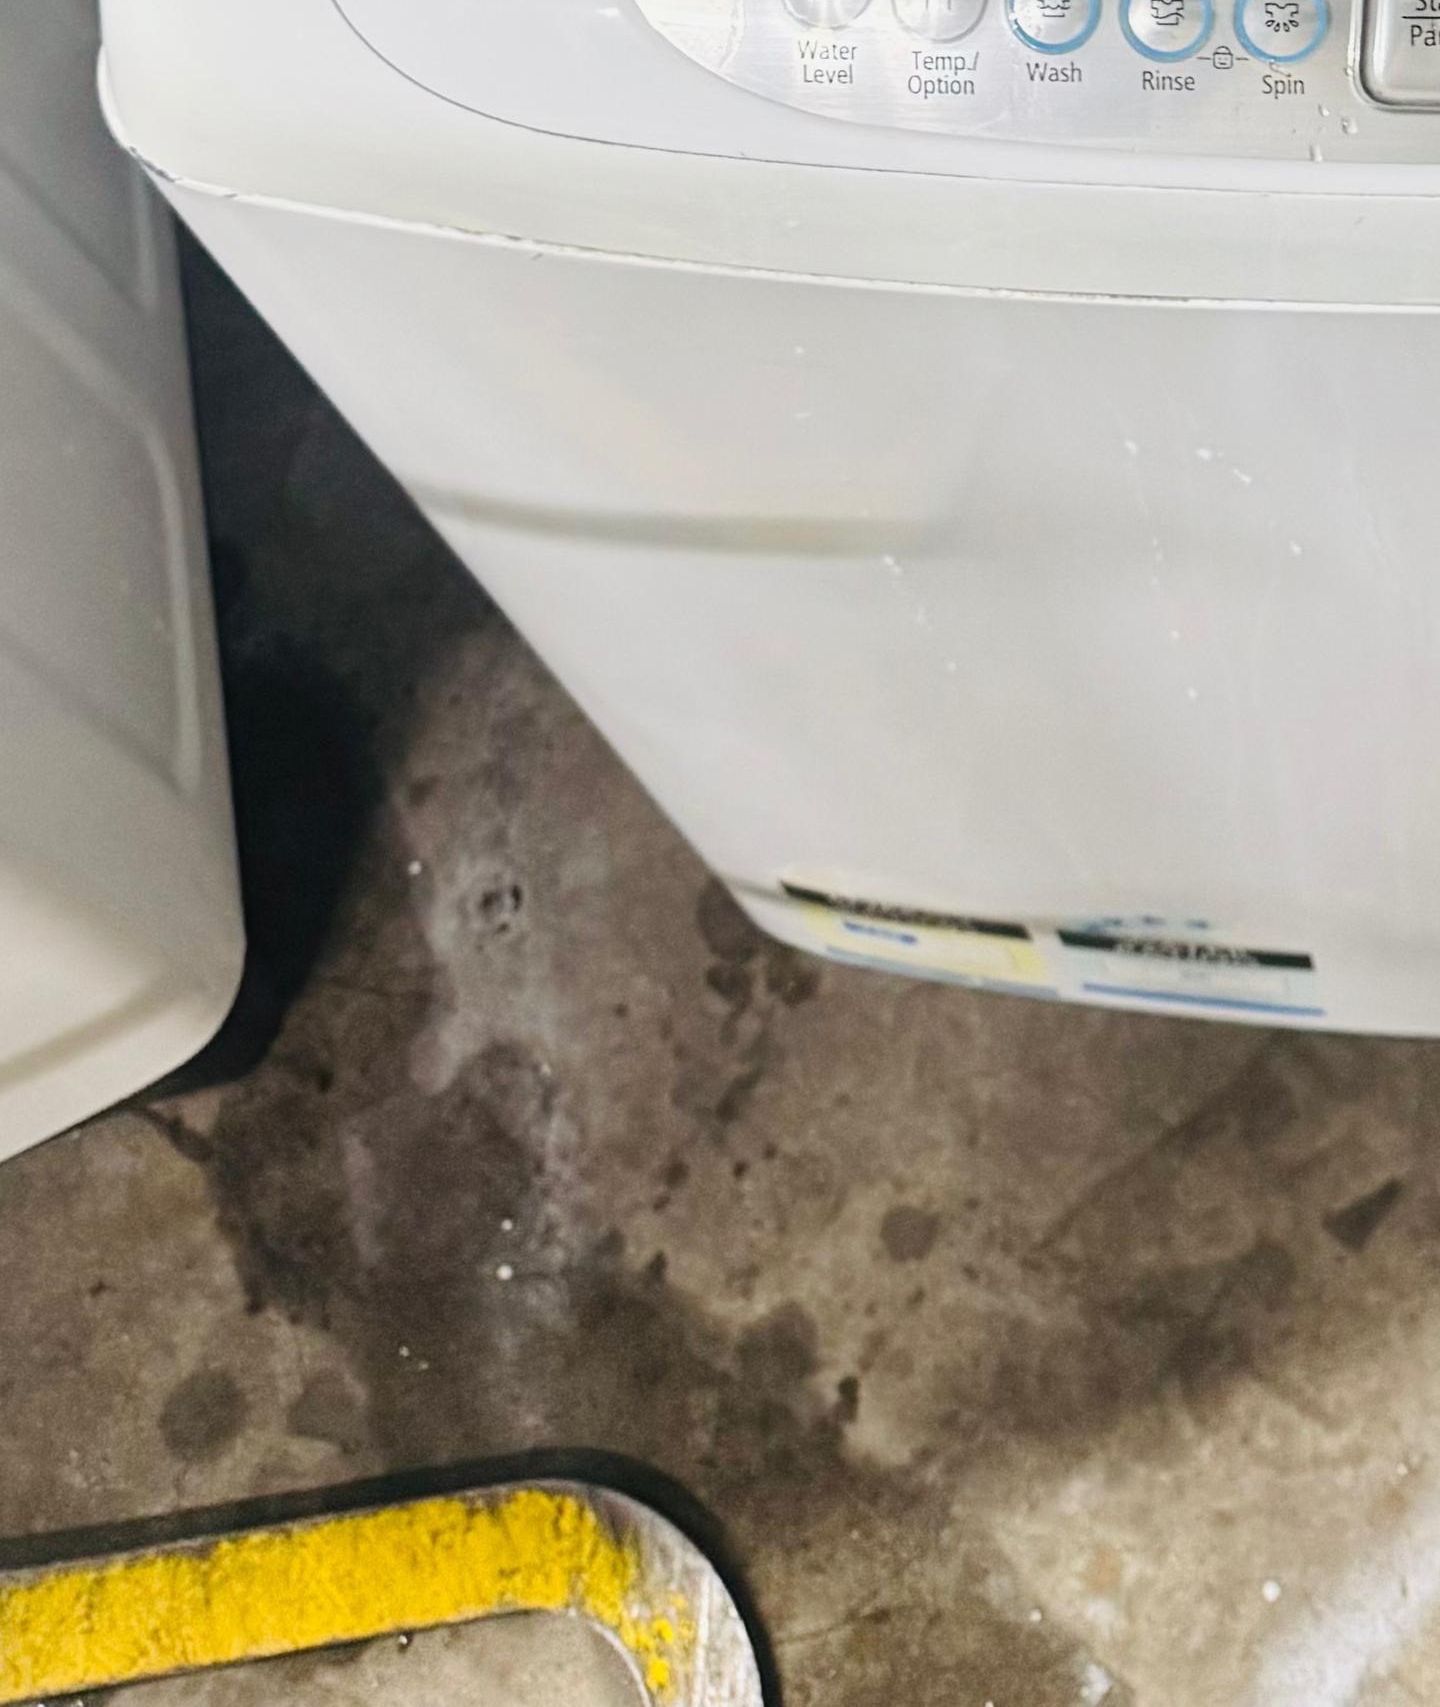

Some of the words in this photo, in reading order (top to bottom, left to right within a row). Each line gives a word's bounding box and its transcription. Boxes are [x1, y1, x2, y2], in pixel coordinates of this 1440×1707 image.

[798, 40, 857, 61] Water
[803, 63, 854, 84] Level
[1026, 62, 1082, 83] Wash
[1142, 71, 1195, 91] Rinse
[908, 76, 975, 99] Option
[1261, 75, 1305, 99] Spin
